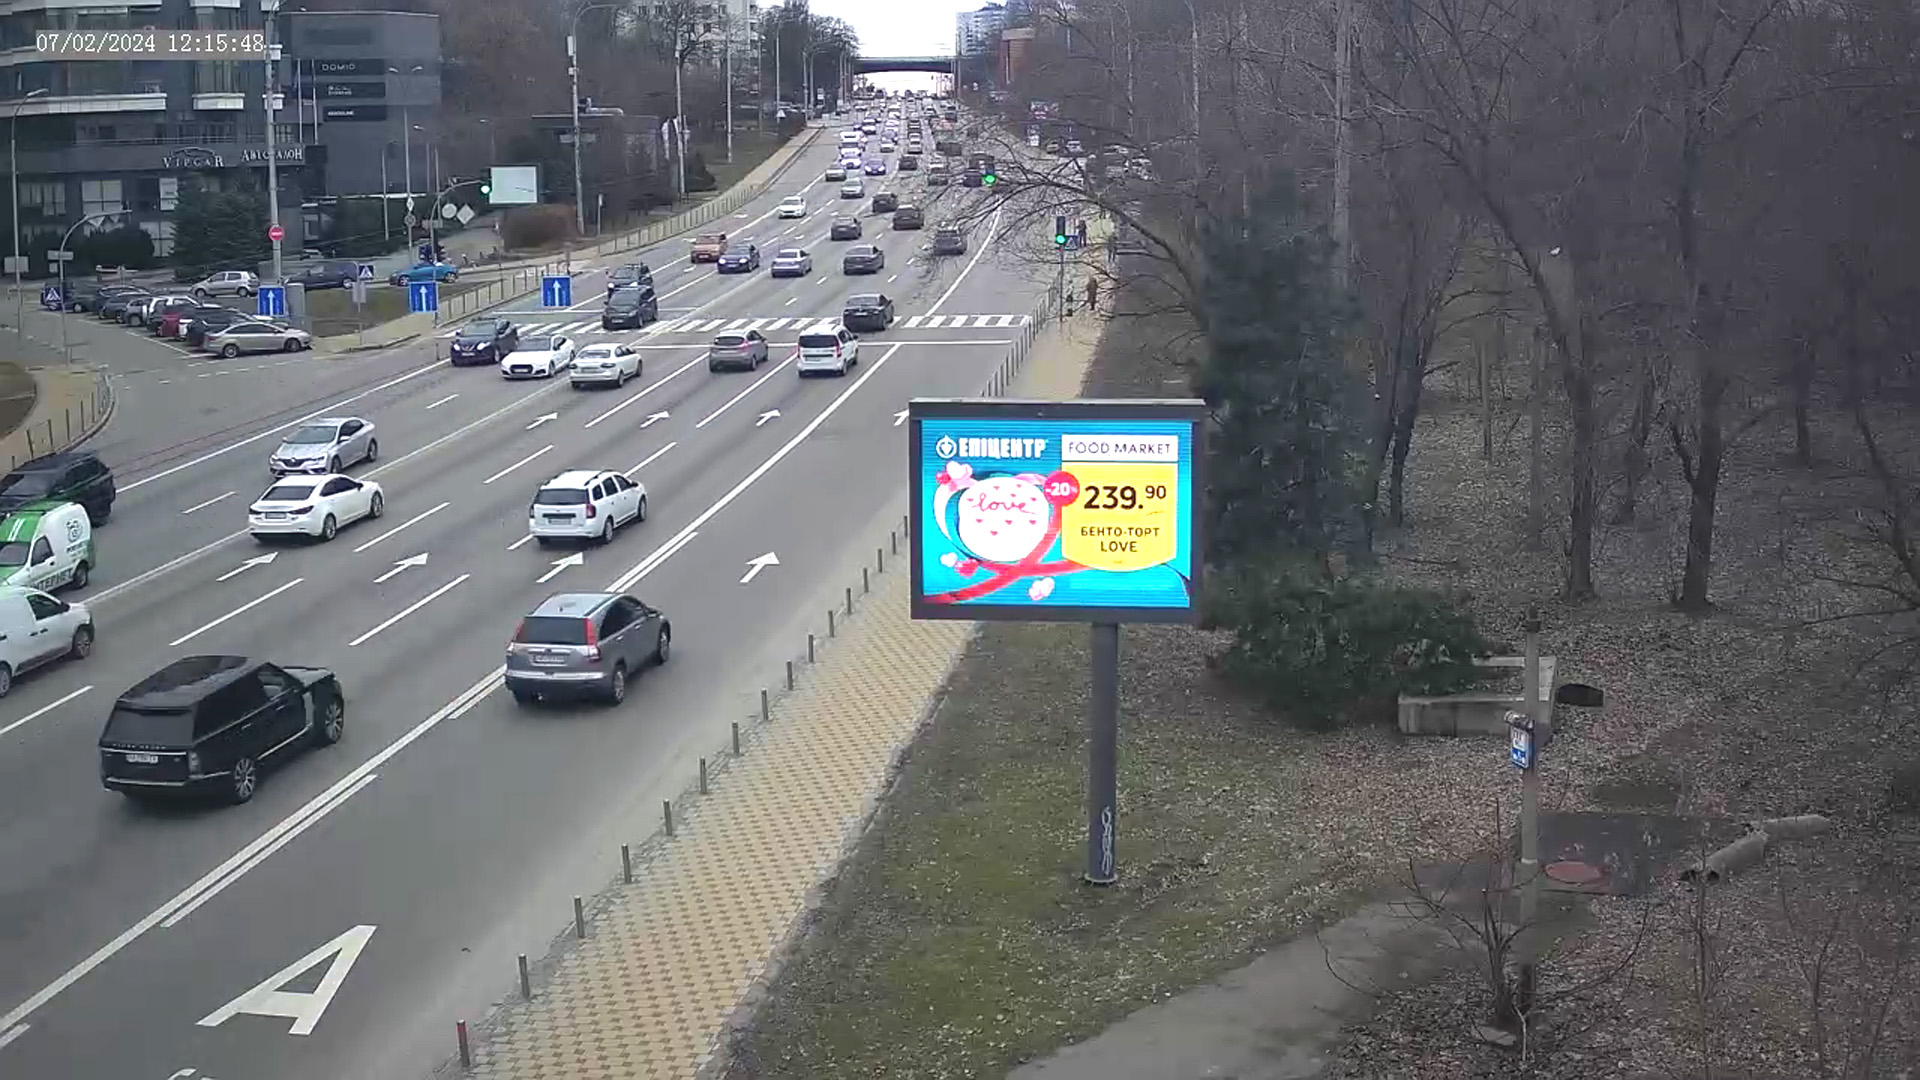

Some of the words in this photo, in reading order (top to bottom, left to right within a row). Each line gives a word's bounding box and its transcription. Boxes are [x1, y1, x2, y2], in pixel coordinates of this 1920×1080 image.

[959, 437, 1047, 459] ЕПІЦЕНТР
[1068, 441, 1110, 454] FOOD
[1114, 441, 1171, 455] MARKET
[971, 492, 1037, 515] love
[1080, 525, 1160, 538] БЕНТО-ТОРТ
[1100, 541, 1138, 553] LOVE
